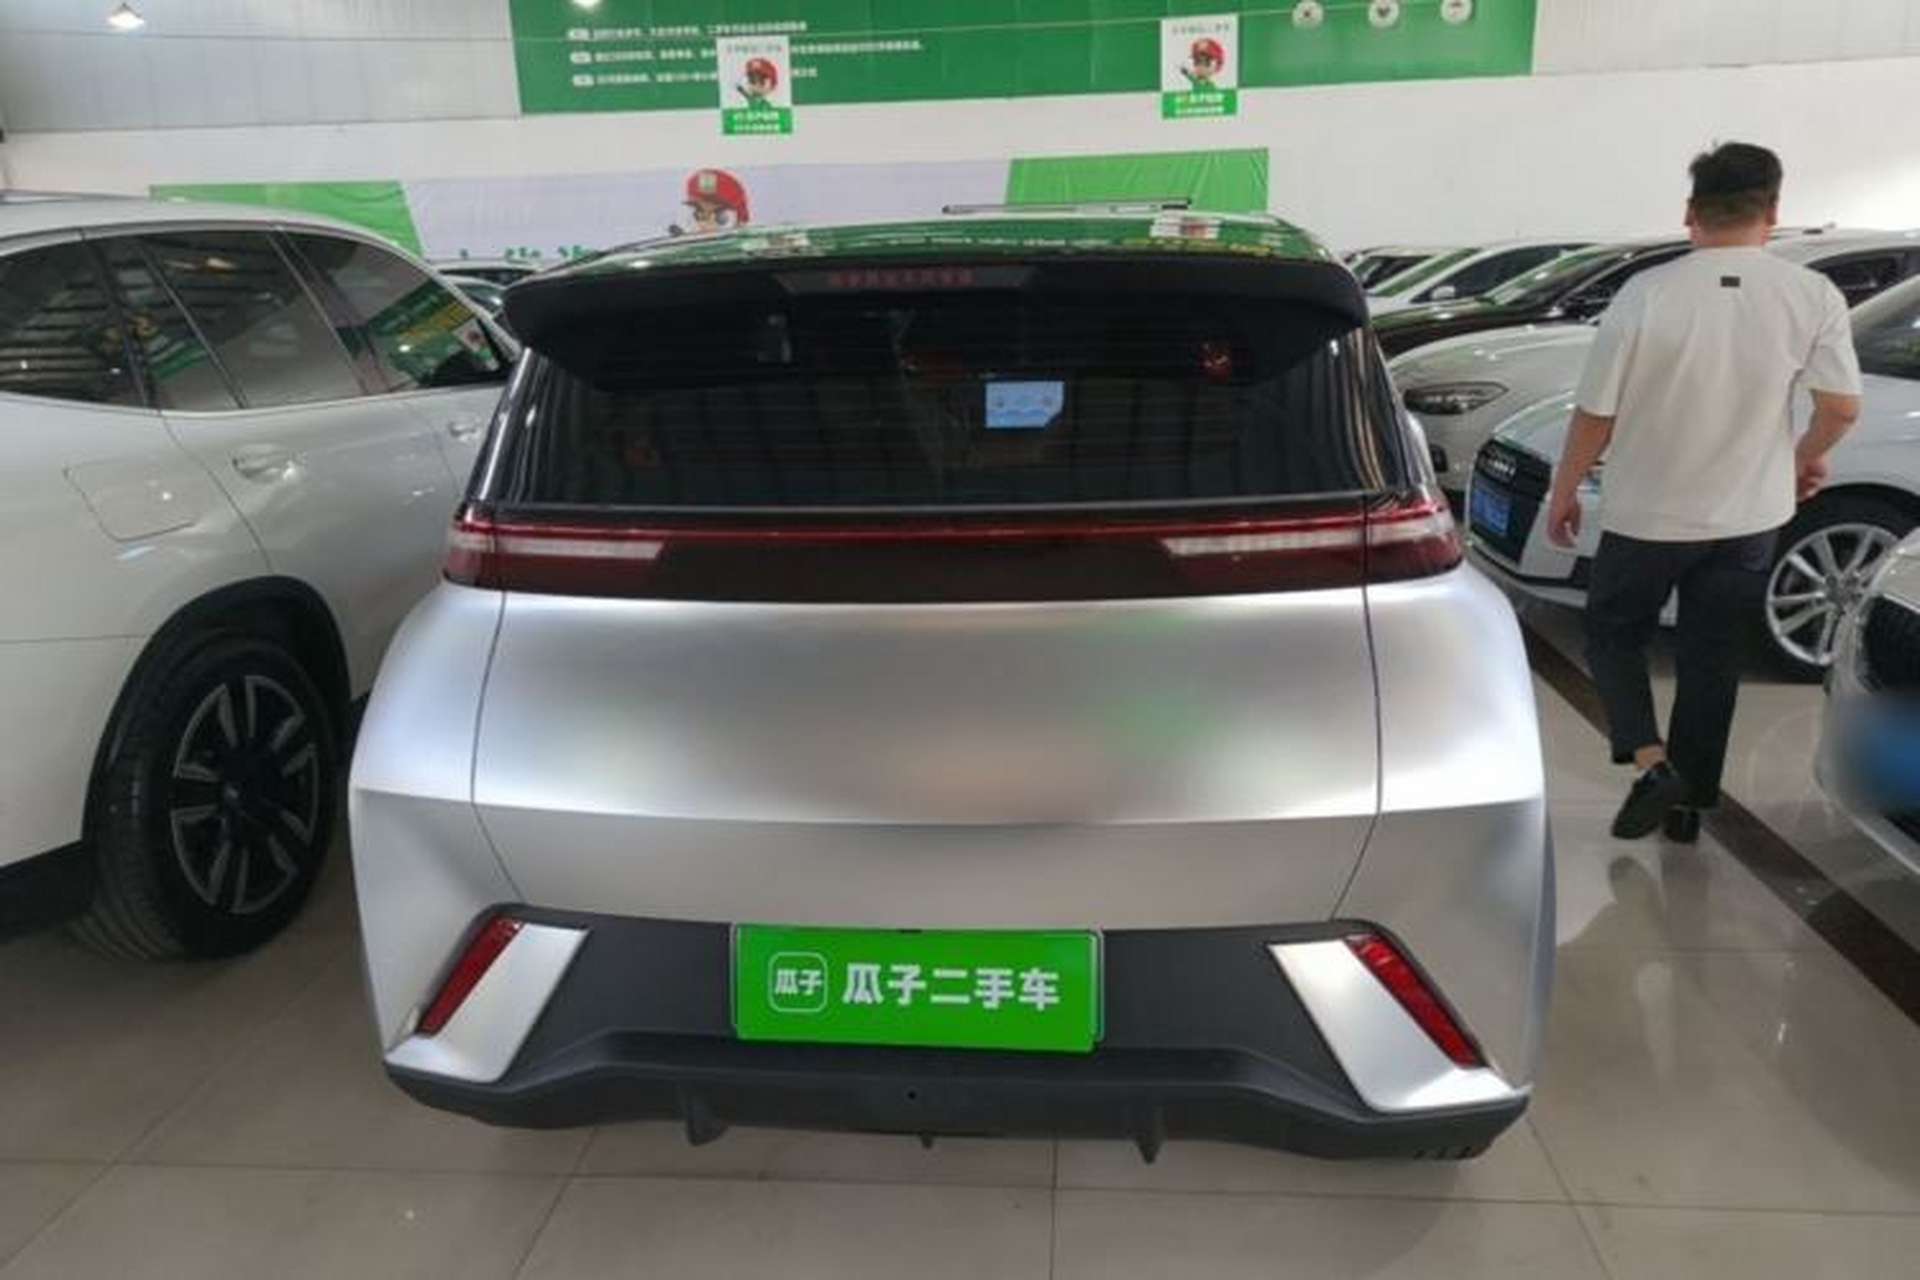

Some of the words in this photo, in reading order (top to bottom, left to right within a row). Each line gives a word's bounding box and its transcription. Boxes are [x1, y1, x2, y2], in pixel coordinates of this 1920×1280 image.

[774, 968, 823, 996] 瓜子
[842, 962, 1060, 1011] 瓜子二手车
